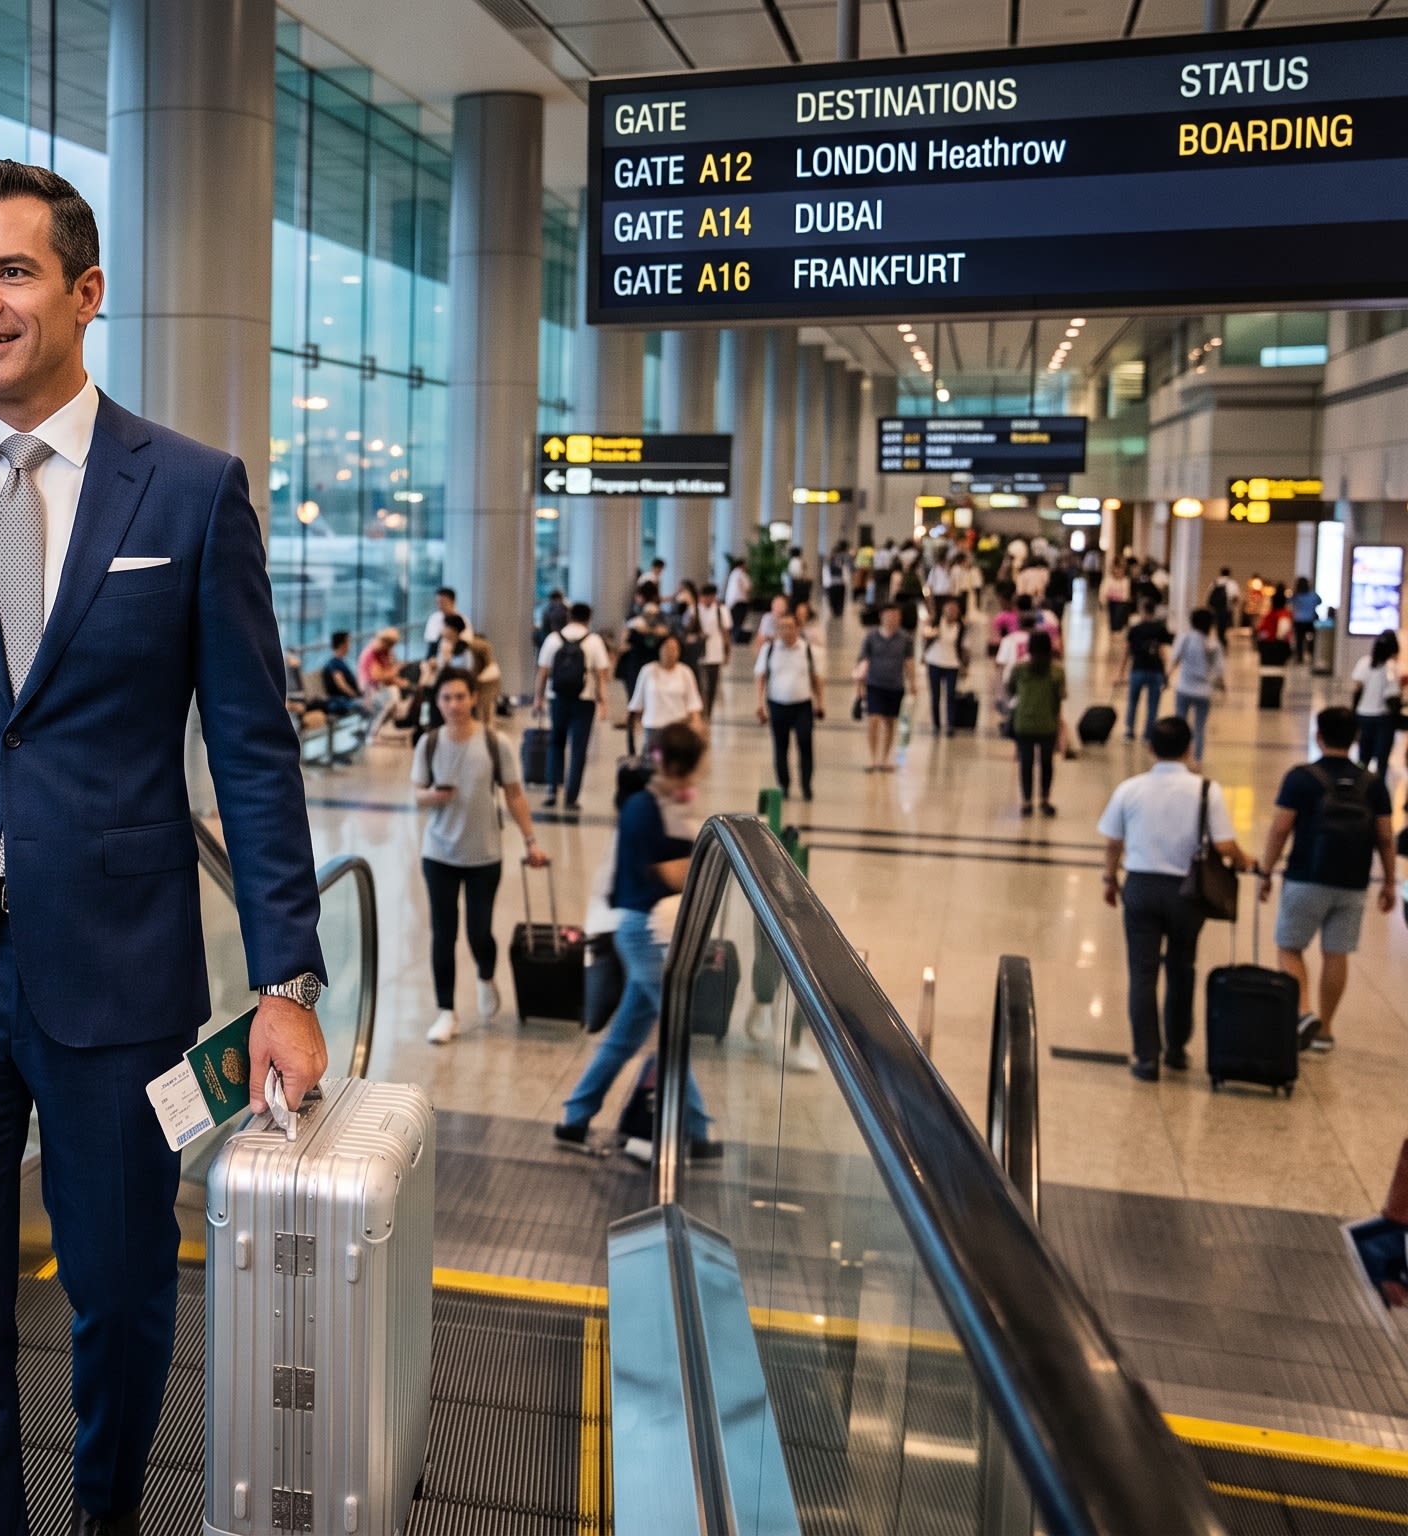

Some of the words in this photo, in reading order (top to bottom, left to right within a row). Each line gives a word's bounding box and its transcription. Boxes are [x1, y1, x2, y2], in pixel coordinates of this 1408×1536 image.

[615, 101, 687, 135] GATE
[796, 77, 1018, 123] DESTINATIONS
[1180, 56, 1309, 98] STATUS
[614, 154, 685, 189] GATE
[699, 151, 752, 184] A12
[796, 141, 917, 178] LONDON
[928, 135, 1067, 171] Heathrow
[1178, 114, 1353, 156] BOARDING
[613, 208, 685, 243] GATE
[698, 206, 752, 238] A14
[794, 199, 883, 234] DUBAI
[613, 263, 683, 297] GATE
[697, 261, 751, 293] A16
[793, 252, 966, 289] FRANKFURT
